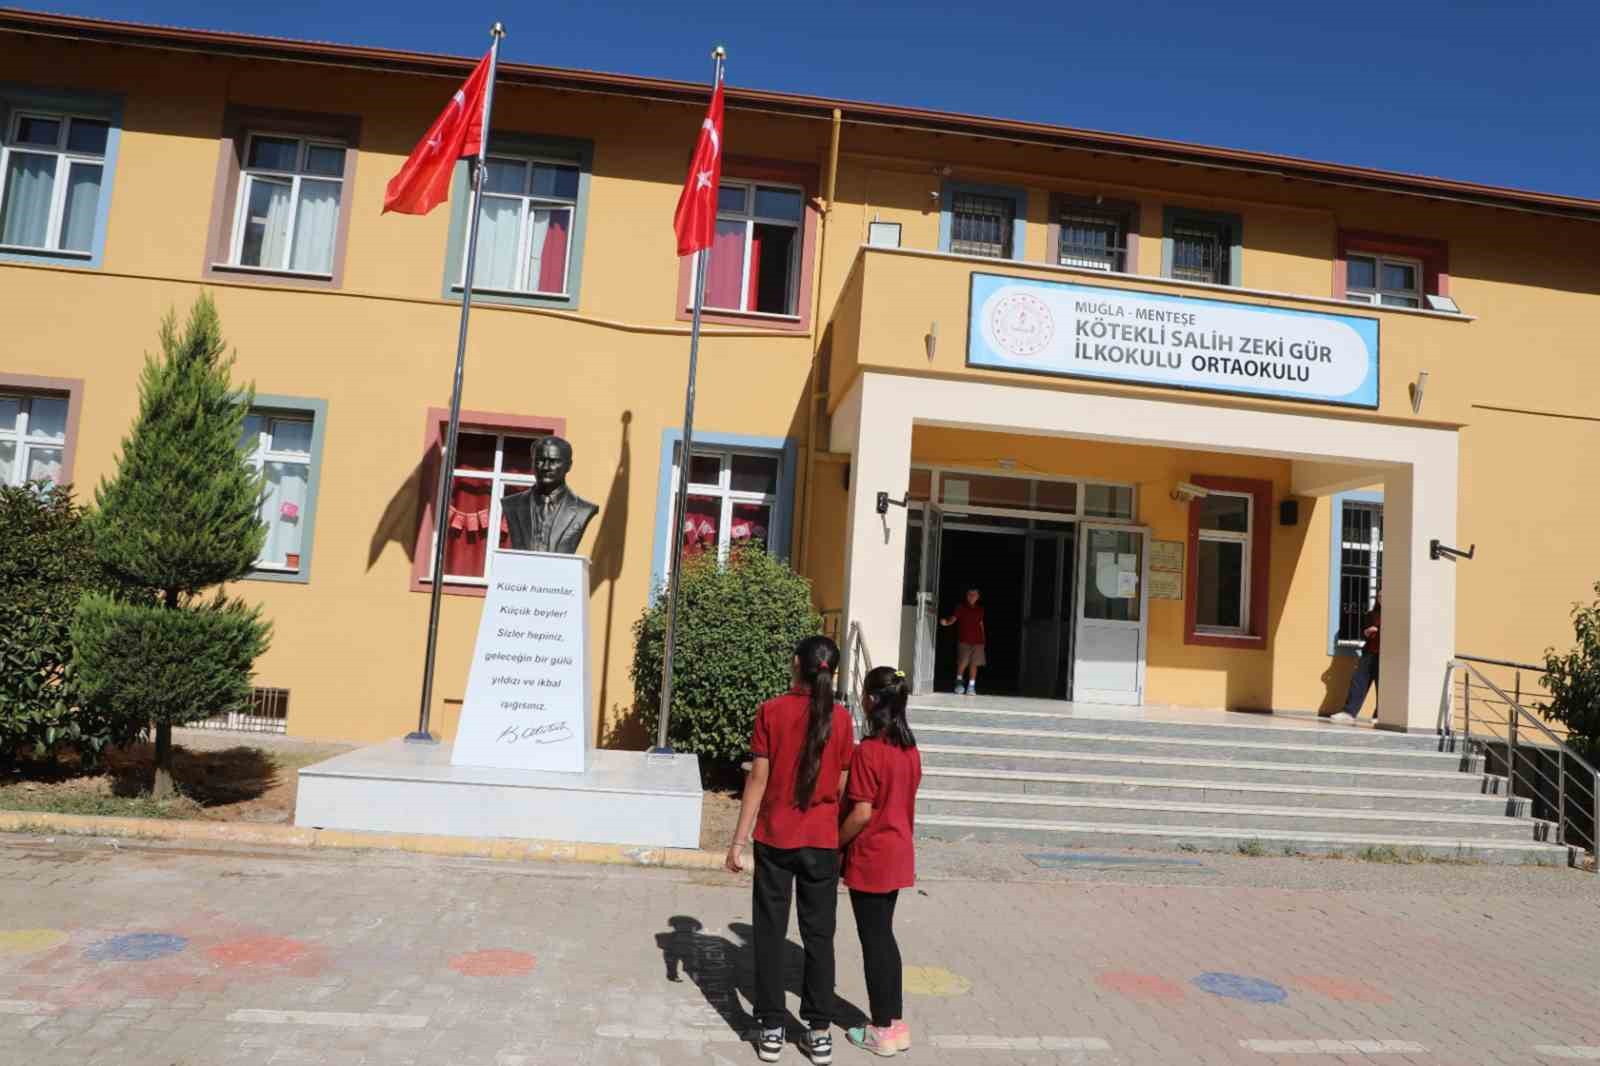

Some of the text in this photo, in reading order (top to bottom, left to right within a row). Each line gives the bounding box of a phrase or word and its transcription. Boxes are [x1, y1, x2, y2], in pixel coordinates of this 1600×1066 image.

[1074, 301, 1125, 317] MUĞLA
[1135, 307, 1197, 328] MENTEŞE
[1075, 317, 1332, 364] KÖTEKLİ SALİH ZEKİ GÜR
[1075, 338, 1310, 383] İLKOKULU ORTAOKULU
[496, 582, 530, 594] Küçük
[499, 606, 532, 616] Küçük
[496, 628, 526, 639] Sizler
[534, 654, 549, 664] bir
[537, 679, 562, 688] ikbal
